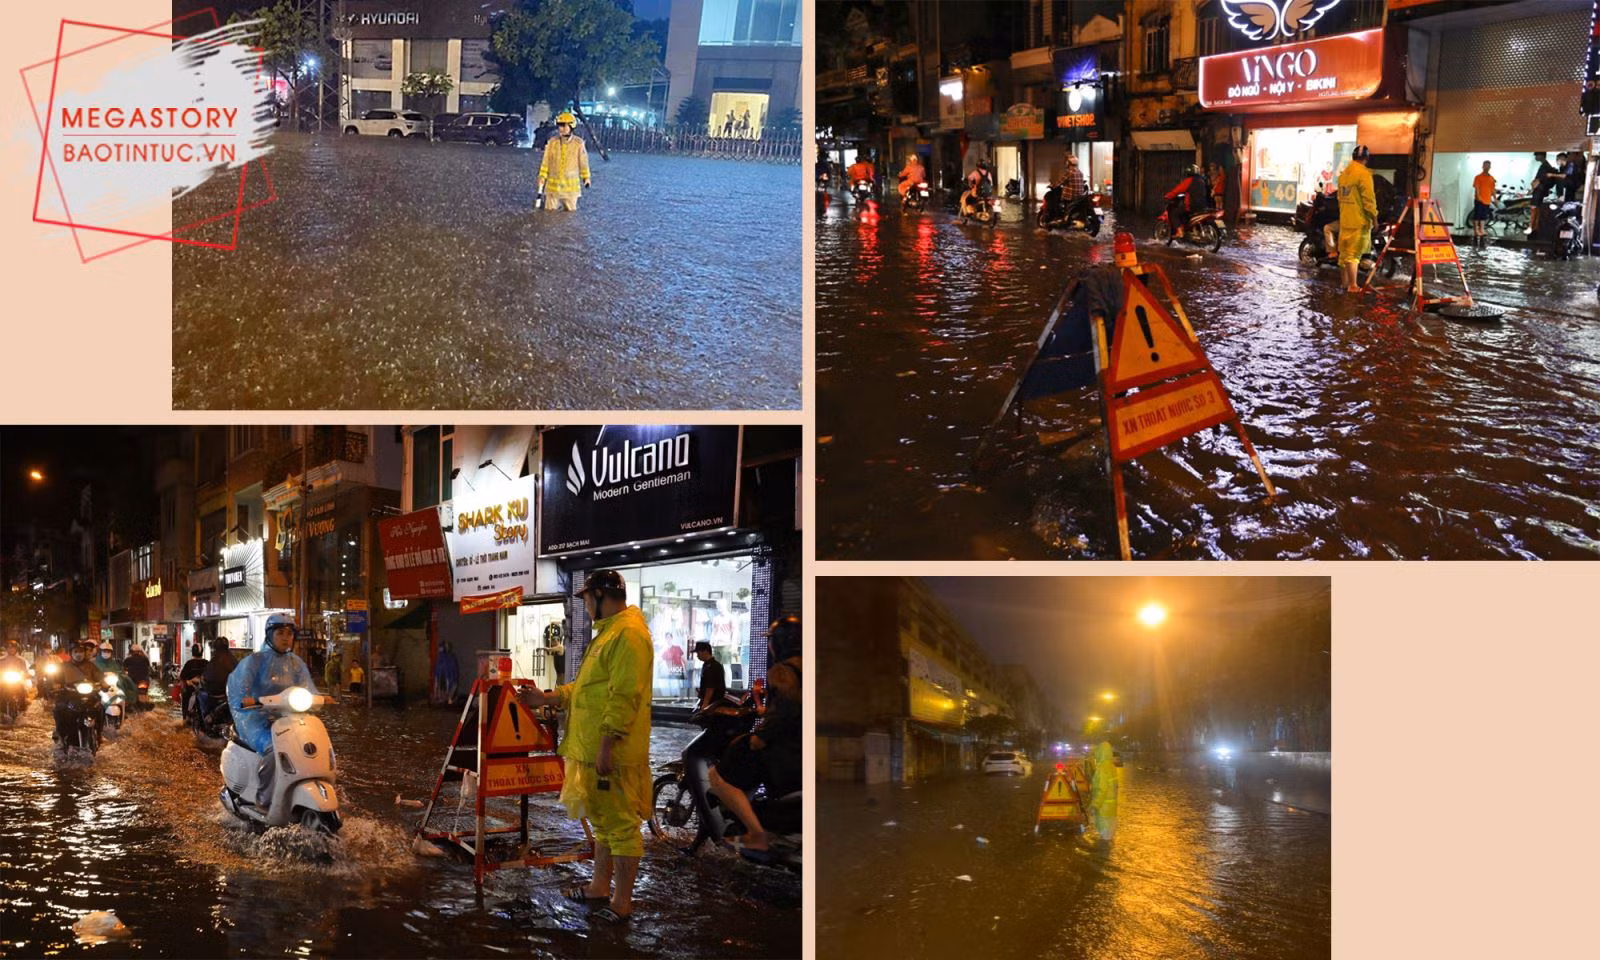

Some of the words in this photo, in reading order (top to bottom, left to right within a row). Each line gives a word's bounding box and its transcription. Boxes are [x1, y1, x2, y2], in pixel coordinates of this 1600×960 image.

[361, 12, 419, 25] HYUNDAI
[1306, 77, 1336, 91] BIKINI
[1122, 416, 1138, 435] XN
[1207, 390, 1215, 404] 3
[592, 433, 690, 488] Vulcano
[593, 485, 630, 501] Modern
[633, 470, 691, 492] Gentleman
[457, 504, 504, 532] SHARK
[507, 497, 529, 521] KU
[680, 517, 723, 530] VULCANO.VN
[494, 524, 528, 544] Story
[515, 763, 530, 774] XN
[557, 773, 564, 782] 3
